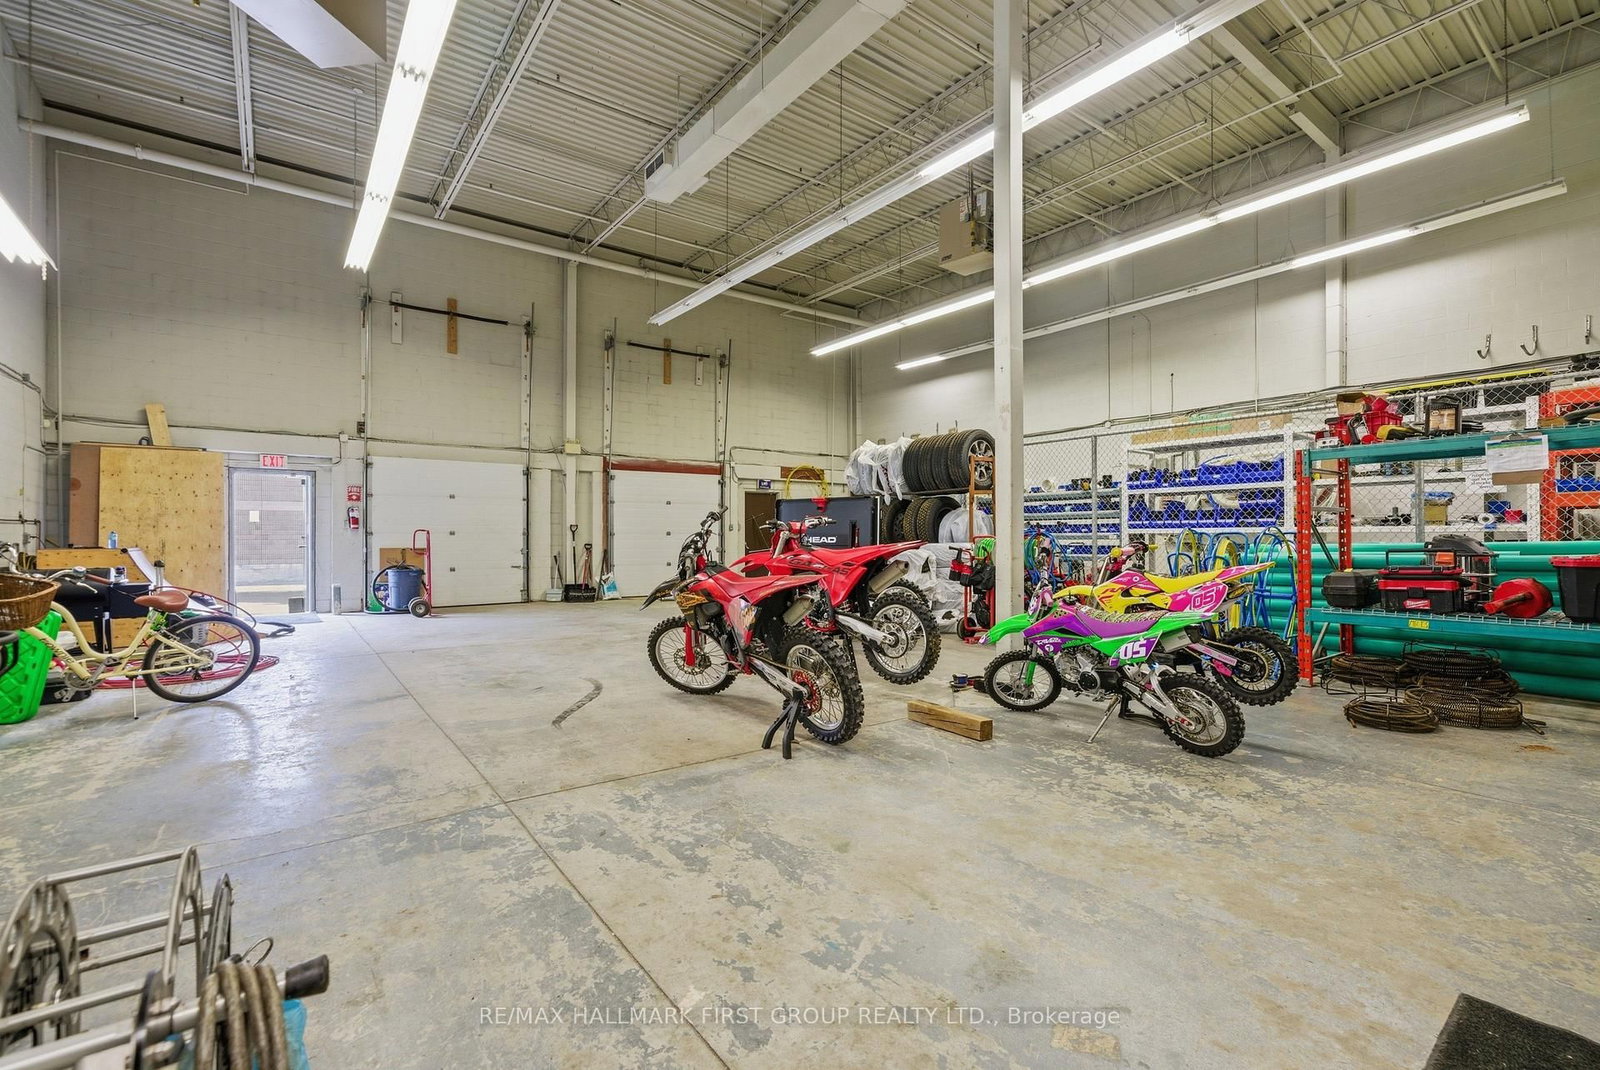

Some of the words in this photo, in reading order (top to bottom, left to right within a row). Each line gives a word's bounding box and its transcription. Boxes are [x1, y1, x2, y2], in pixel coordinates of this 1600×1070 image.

[262, 455, 284, 467] EXIT
[1192, 588, 1217, 610] 05
[1120, 640, 1147, 659] 05
